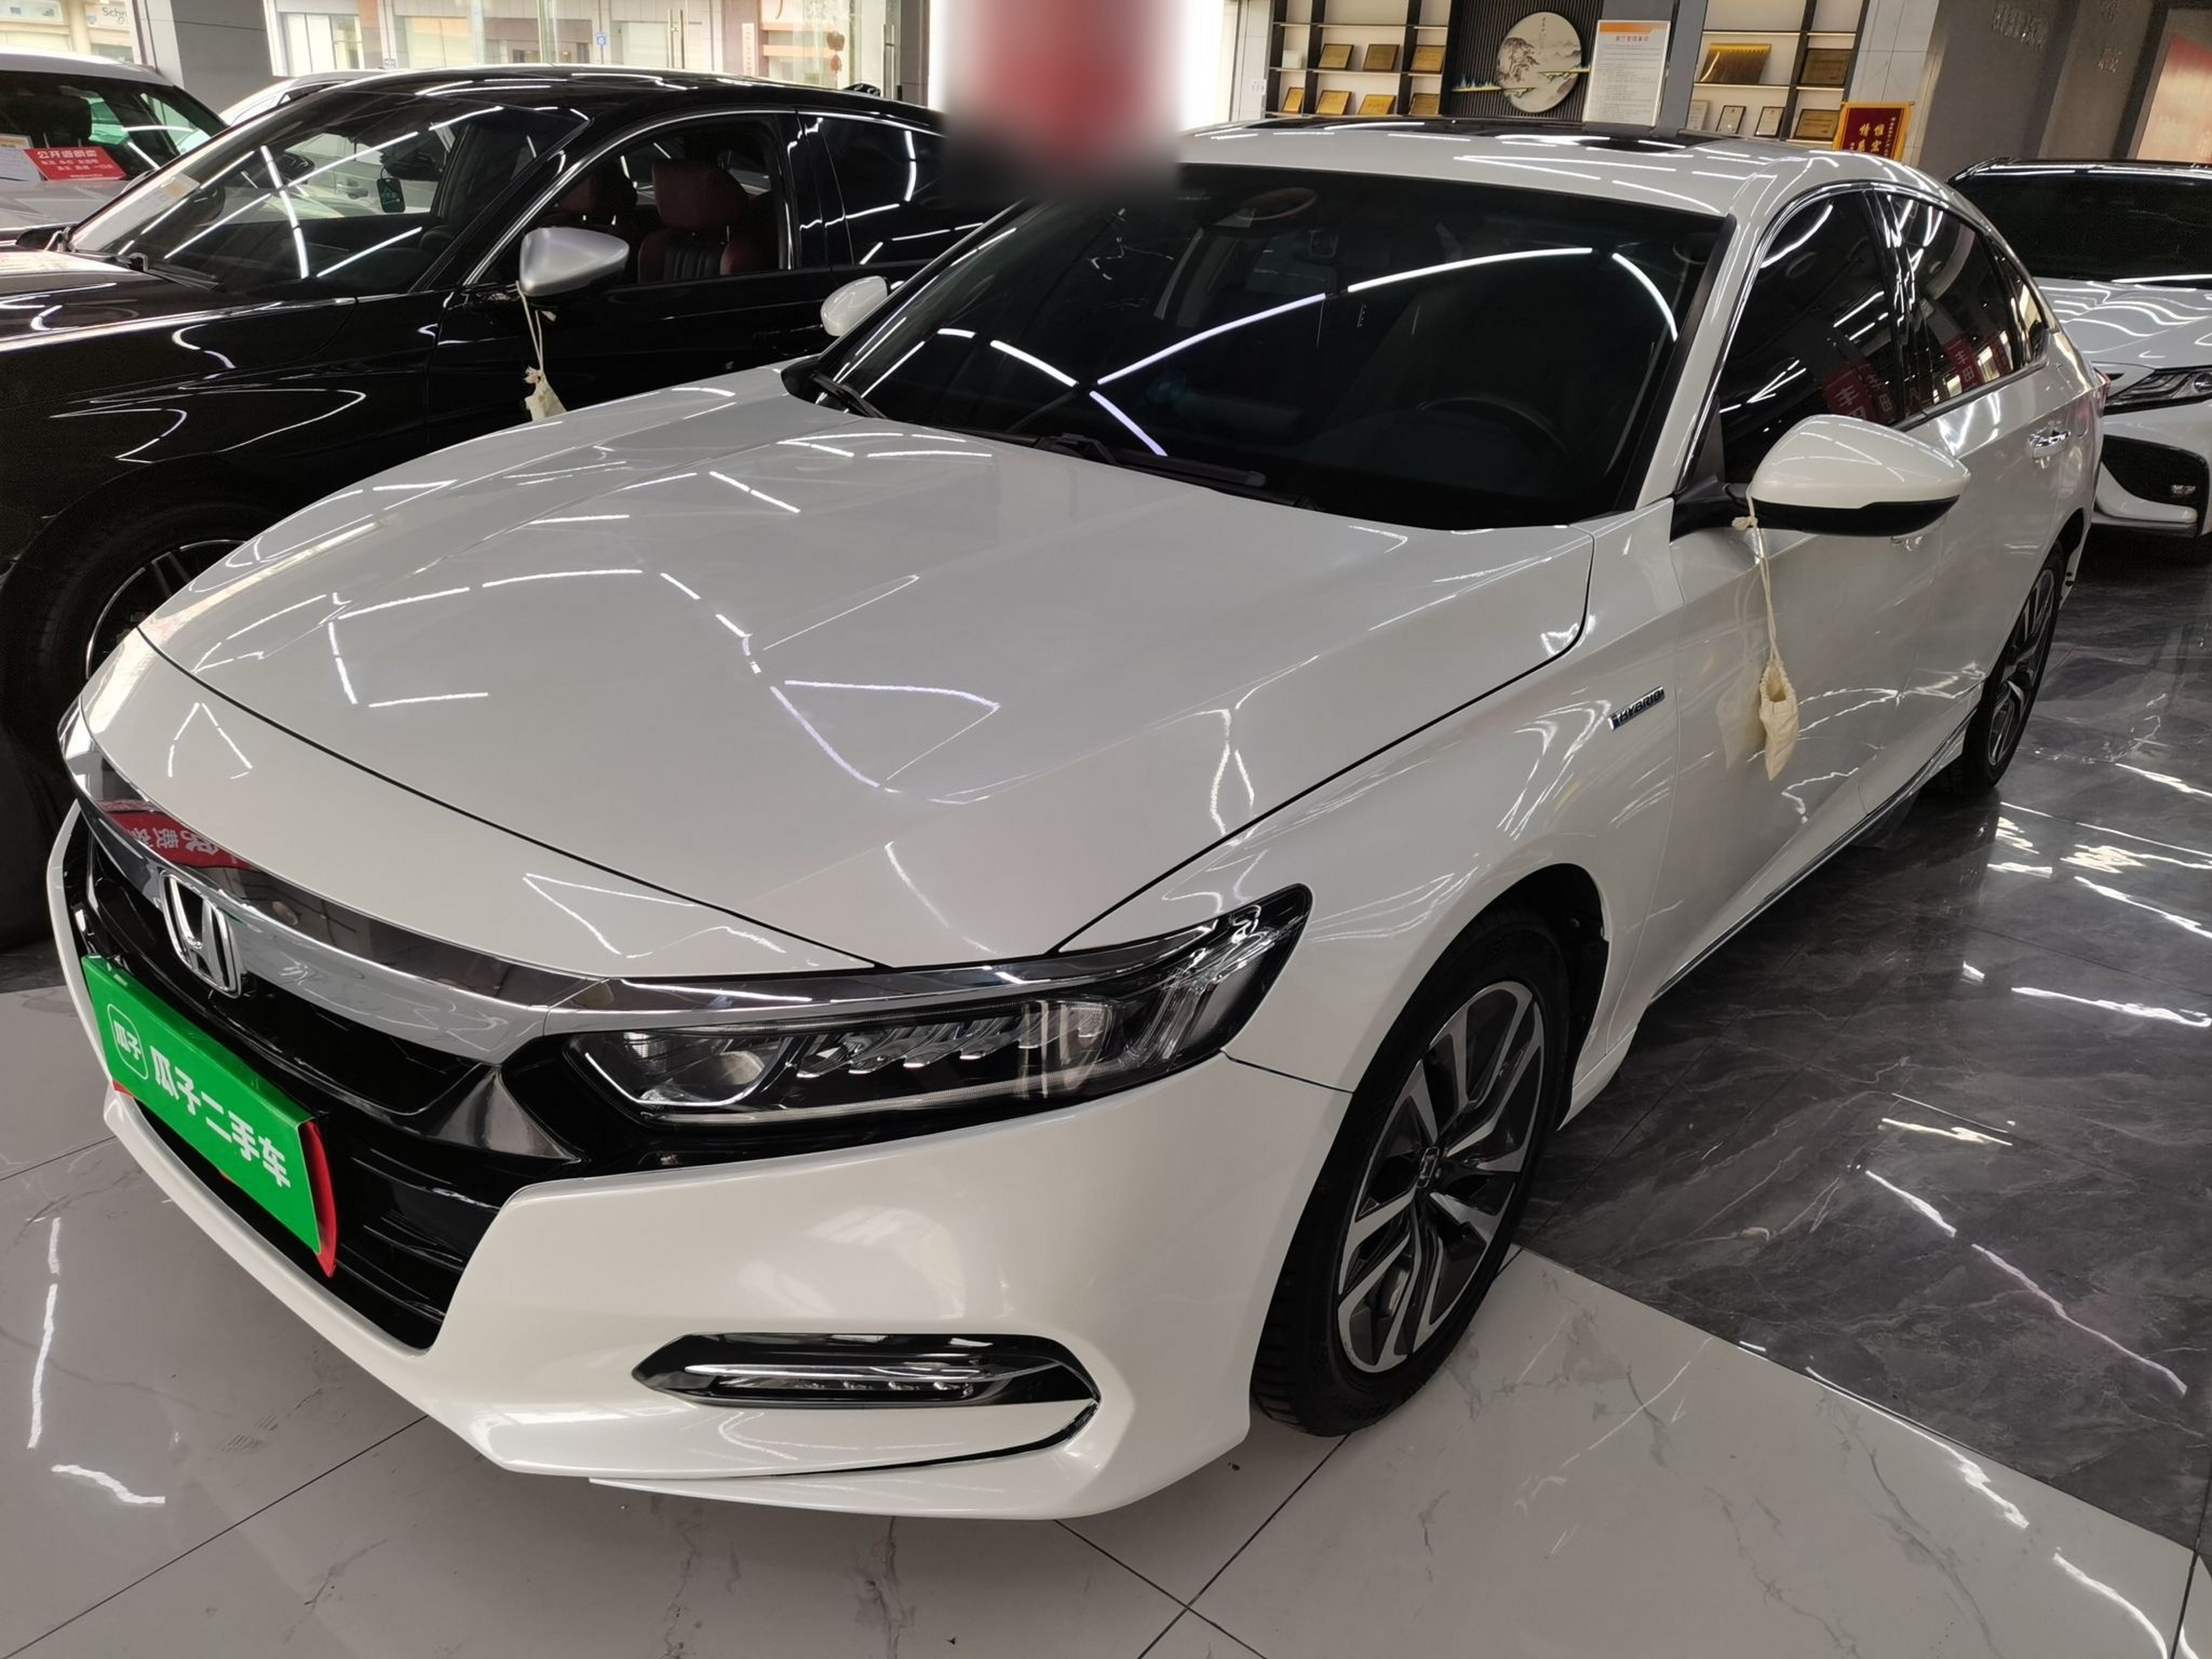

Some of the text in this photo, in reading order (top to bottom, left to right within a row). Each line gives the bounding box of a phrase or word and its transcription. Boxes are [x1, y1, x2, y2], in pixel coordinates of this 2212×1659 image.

[1617, 688, 1664, 724] HYBRID
[114, 1019, 142, 1061] 瓜子
[150, 1045, 291, 1188] 瓜子二手车
